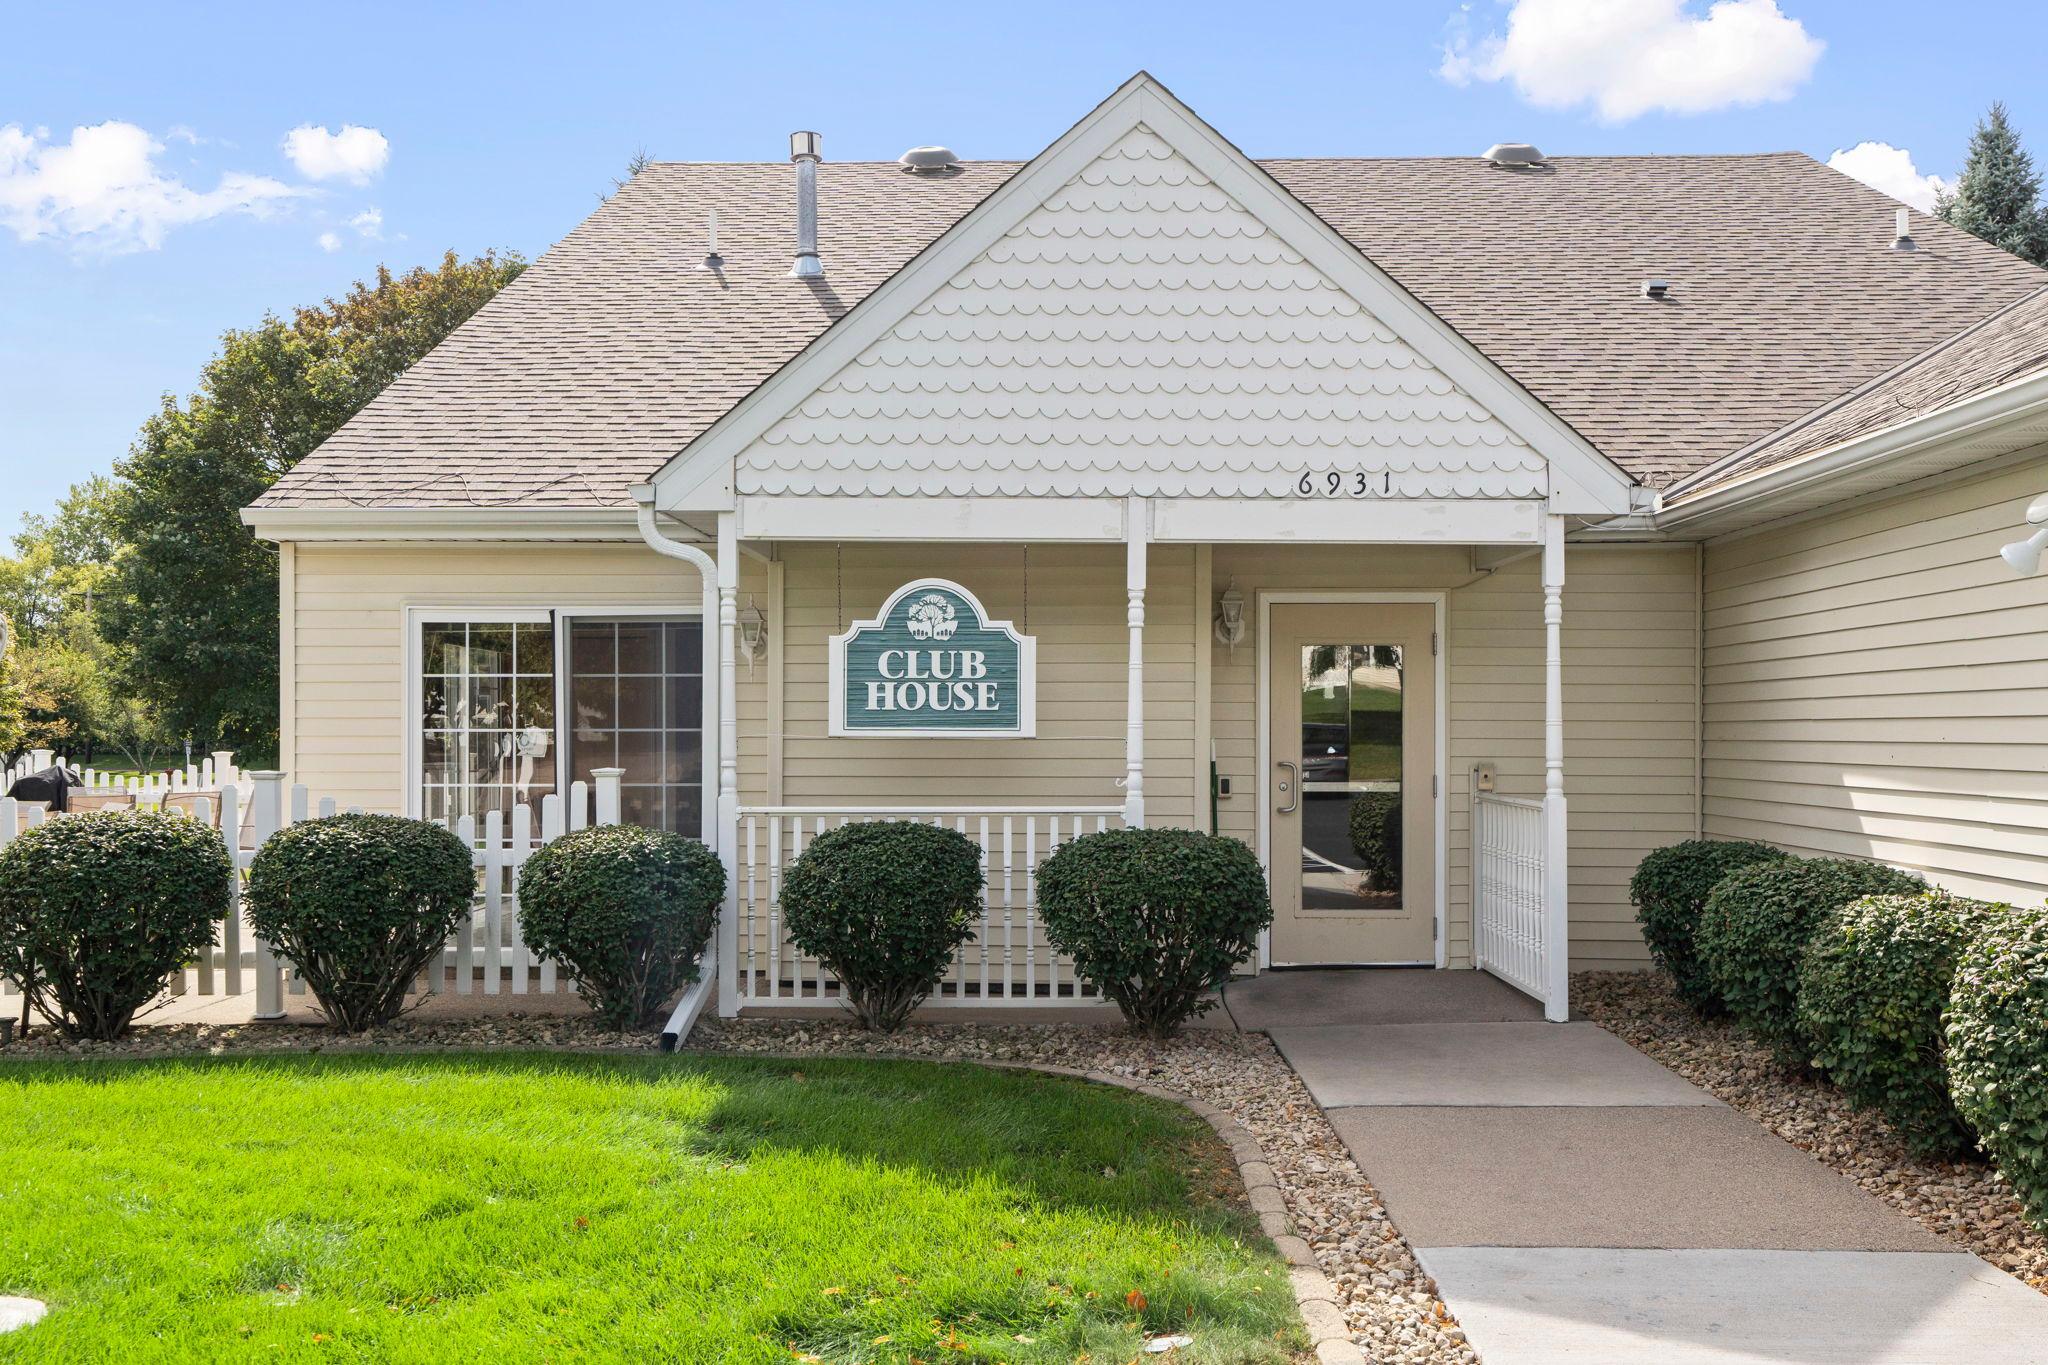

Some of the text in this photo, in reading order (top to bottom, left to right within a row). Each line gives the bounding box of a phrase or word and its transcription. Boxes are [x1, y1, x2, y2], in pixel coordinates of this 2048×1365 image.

[1299, 471, 1390, 495] 6931
[878, 650, 986, 679] CLUB
[865, 681, 1000, 711] HOUSE
